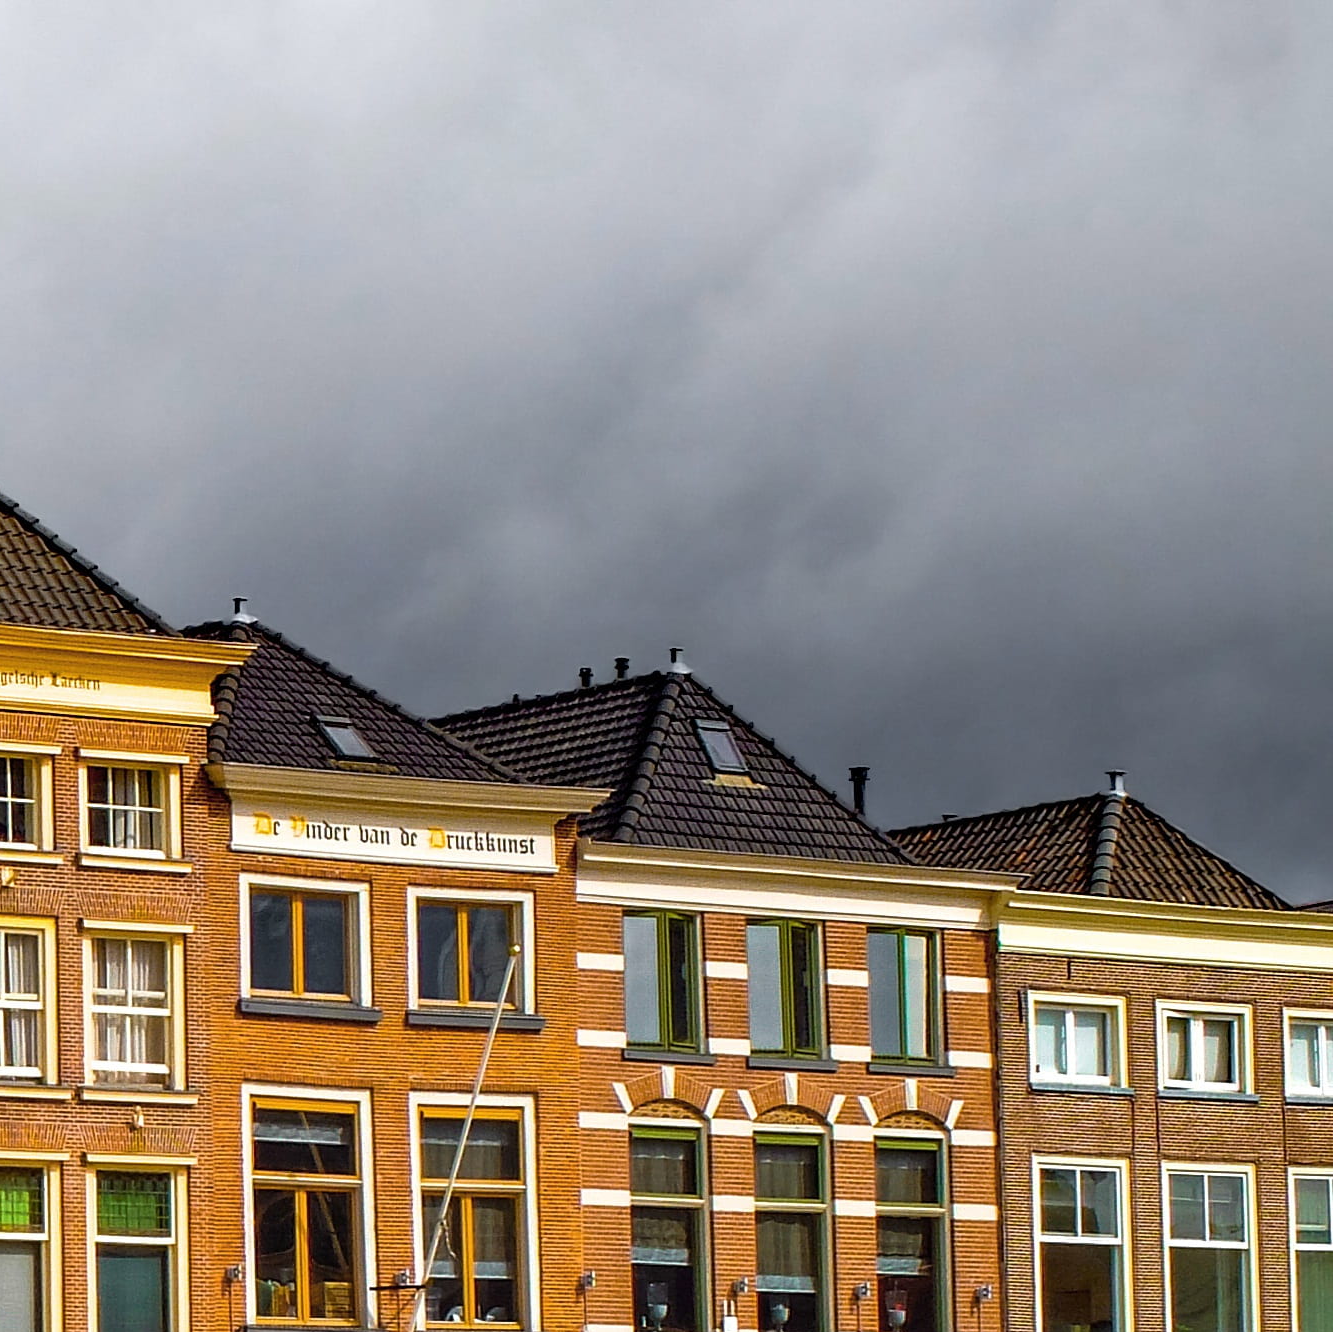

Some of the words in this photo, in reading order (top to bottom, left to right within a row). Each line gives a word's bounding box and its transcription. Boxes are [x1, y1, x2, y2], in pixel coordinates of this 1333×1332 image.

[253, 811, 281, 836] De
[359, 824, 391, 846] van
[399, 826, 418, 847] de
[427, 826, 536, 855] Druckkunst
